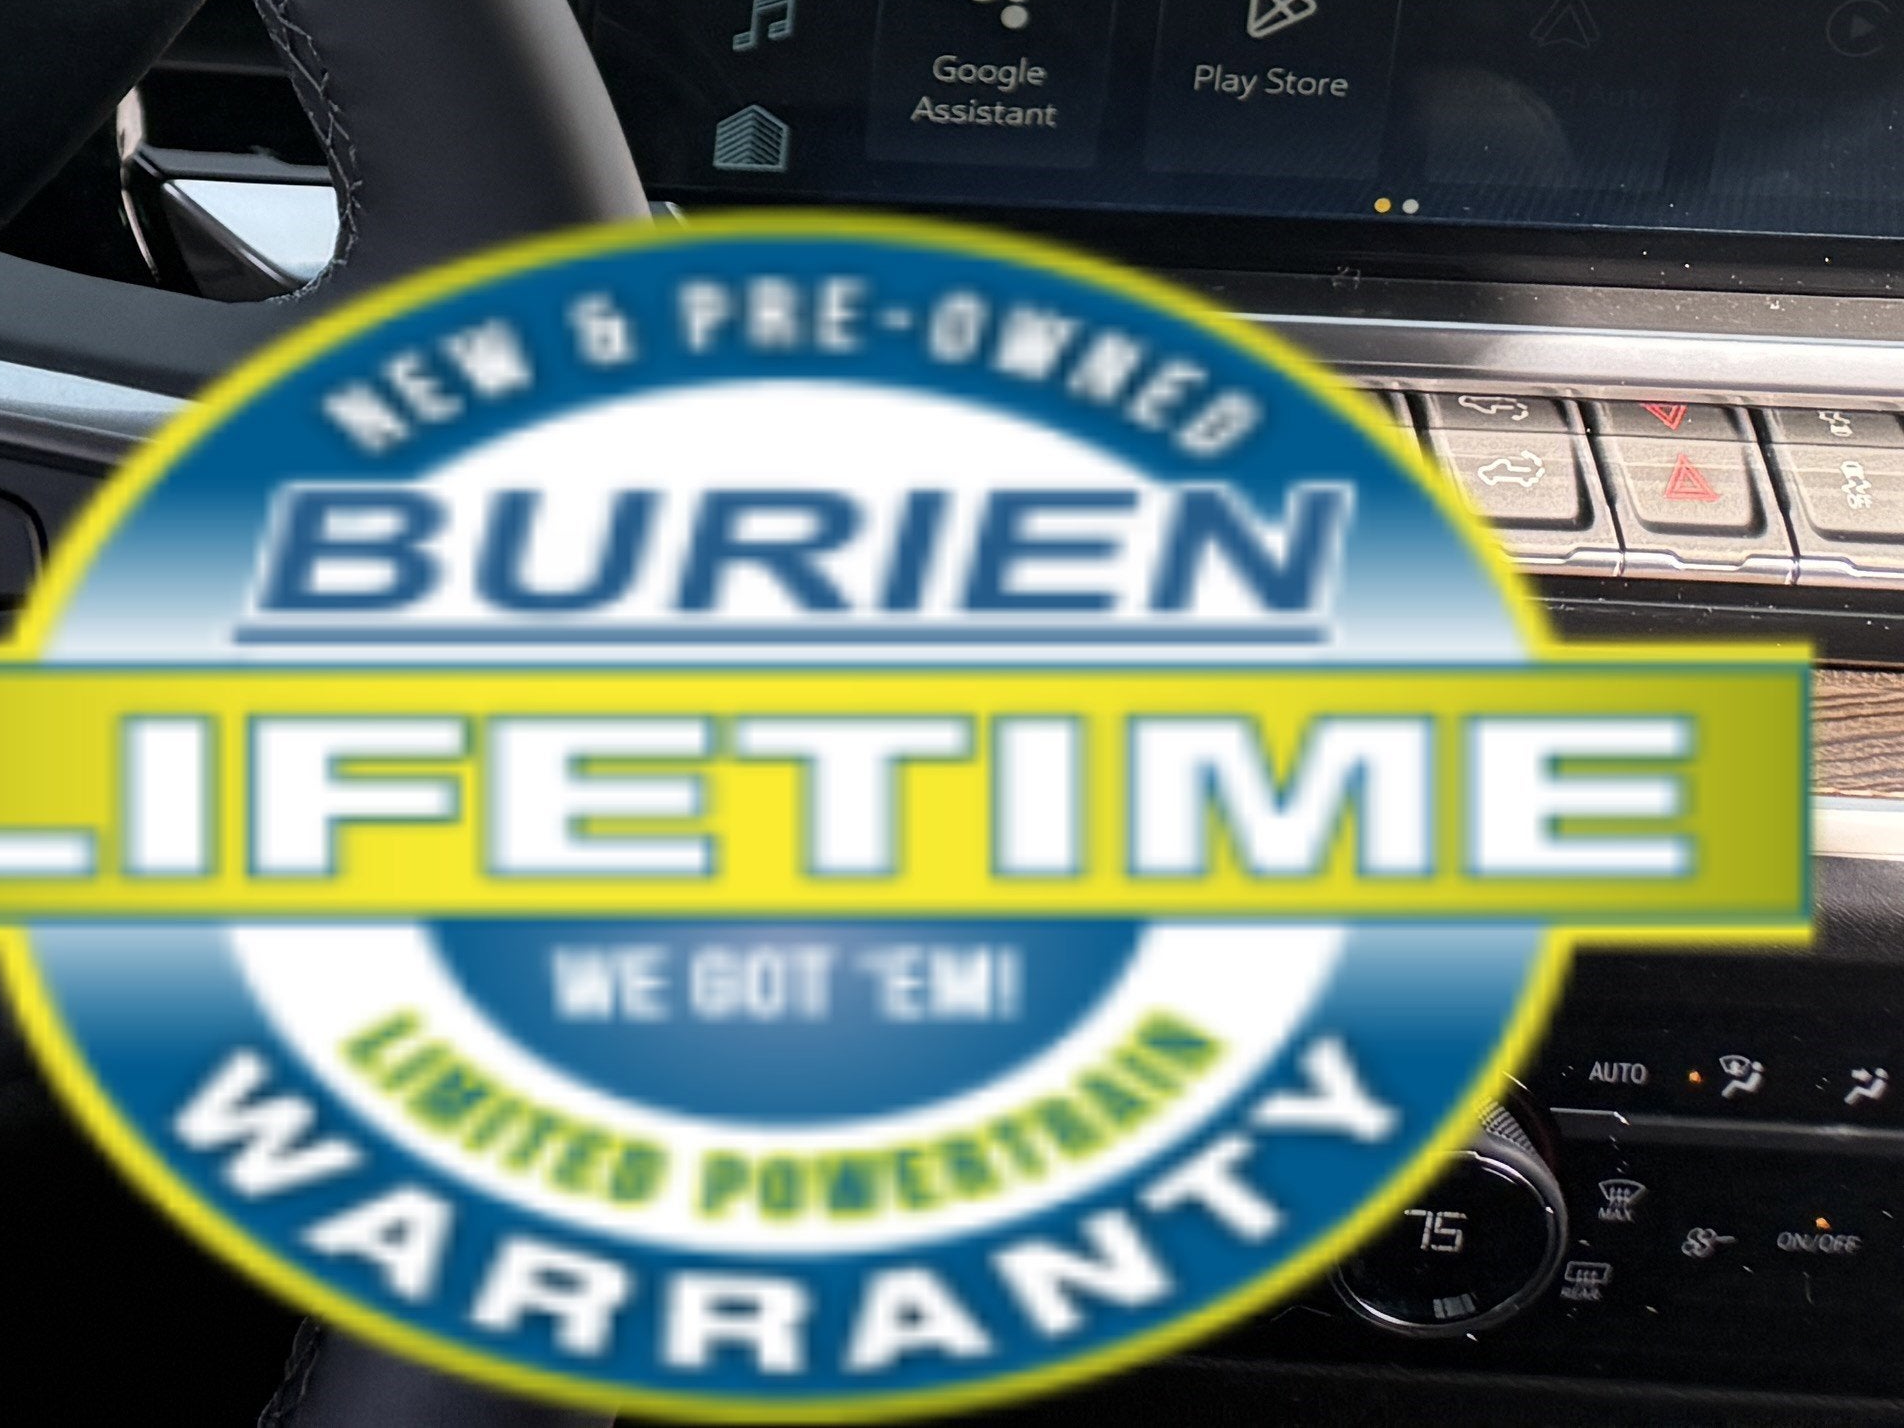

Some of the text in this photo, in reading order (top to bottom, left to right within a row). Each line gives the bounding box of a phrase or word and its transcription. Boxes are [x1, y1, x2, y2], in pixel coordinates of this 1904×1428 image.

[931, 55, 1047, 89] Google
[1192, 64, 1349, 100] Play Store
[911, 95, 1058, 128] Assistant
[1589, 1062, 1648, 1085] AUTO
[1404, 1209, 1467, 1252] 75
